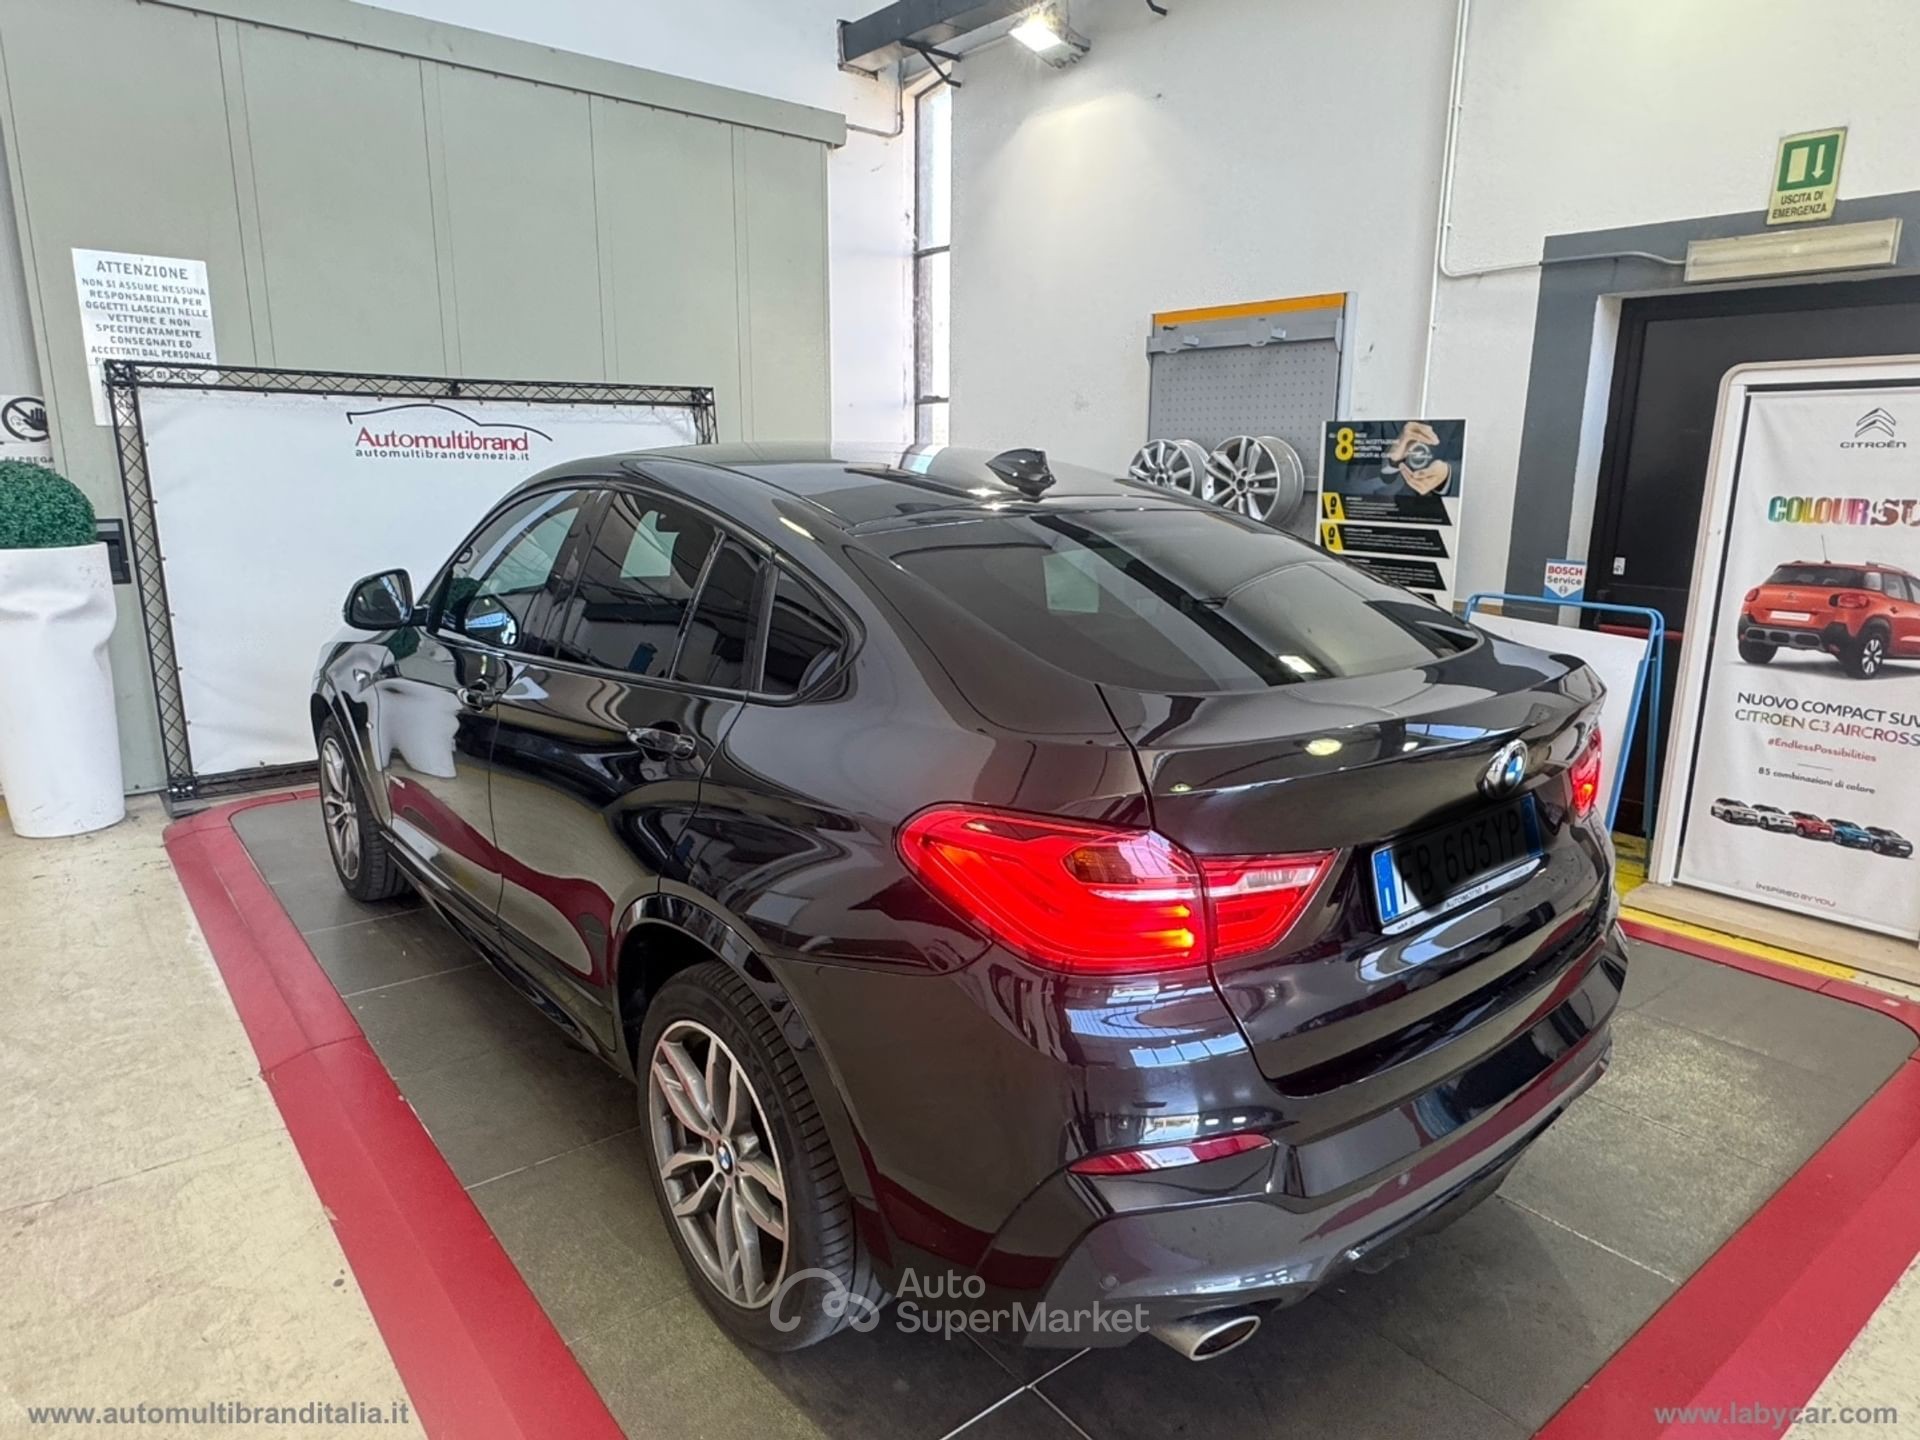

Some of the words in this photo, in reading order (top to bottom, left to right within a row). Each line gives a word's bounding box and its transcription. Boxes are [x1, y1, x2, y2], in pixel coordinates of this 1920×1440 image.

[1781, 191, 1811, 205] USCITA
[1814, 191, 1824, 201] DI
[1772, 203, 1827, 219] EMERGENZA
[96, 260, 188, 280] ATTENZIONE
[82, 278, 103, 287] NON
[106, 280, 116, 288] SI
[119, 281, 159, 292] ASSUME
[162, 285, 206, 296] NESSUNA
[85, 301, 128, 312] OGGETTI
[131, 304, 175, 315] LASCIATI
[178, 308, 208, 318] NELLE
[182, 297, 202, 306] PER
[107, 313, 157, 324] VETTURE
[160, 317, 166, 325] E
[169, 318, 191, 327] NON
[95, 324, 202, 339] SPECIFICATAMENTE
[110, 336, 176, 348] CONSEGNATI
[91, 346, 140, 356] ACCETTATI
[142, 349, 159, 357] DAL
[162, 350, 212, 360] PERSONALE
[355, 427, 529, 451] Automultibrand
[1335, 427, 1354, 461] 8
[355, 448, 529, 461] automultibrandvenezia.it
[1768, 496, 1870, 526] COLOUR
[1548, 565, 1583, 576] BOSCH
[1547, 575, 1582, 586] Service
[1737, 692, 1799, 711] NUOVO
[1801, 700, 1886, 723] COMPACT
[1808, 719, 1830, 733] C3
[1832, 722, 1920, 747] AIRCROSS
[1767, 737, 1877, 763] #EndlessPossibilities
[1773, 770, 1833, 787] combinazioni
[1835, 780, 1844, 789] di
[1846, 783, 1875, 795] colore
